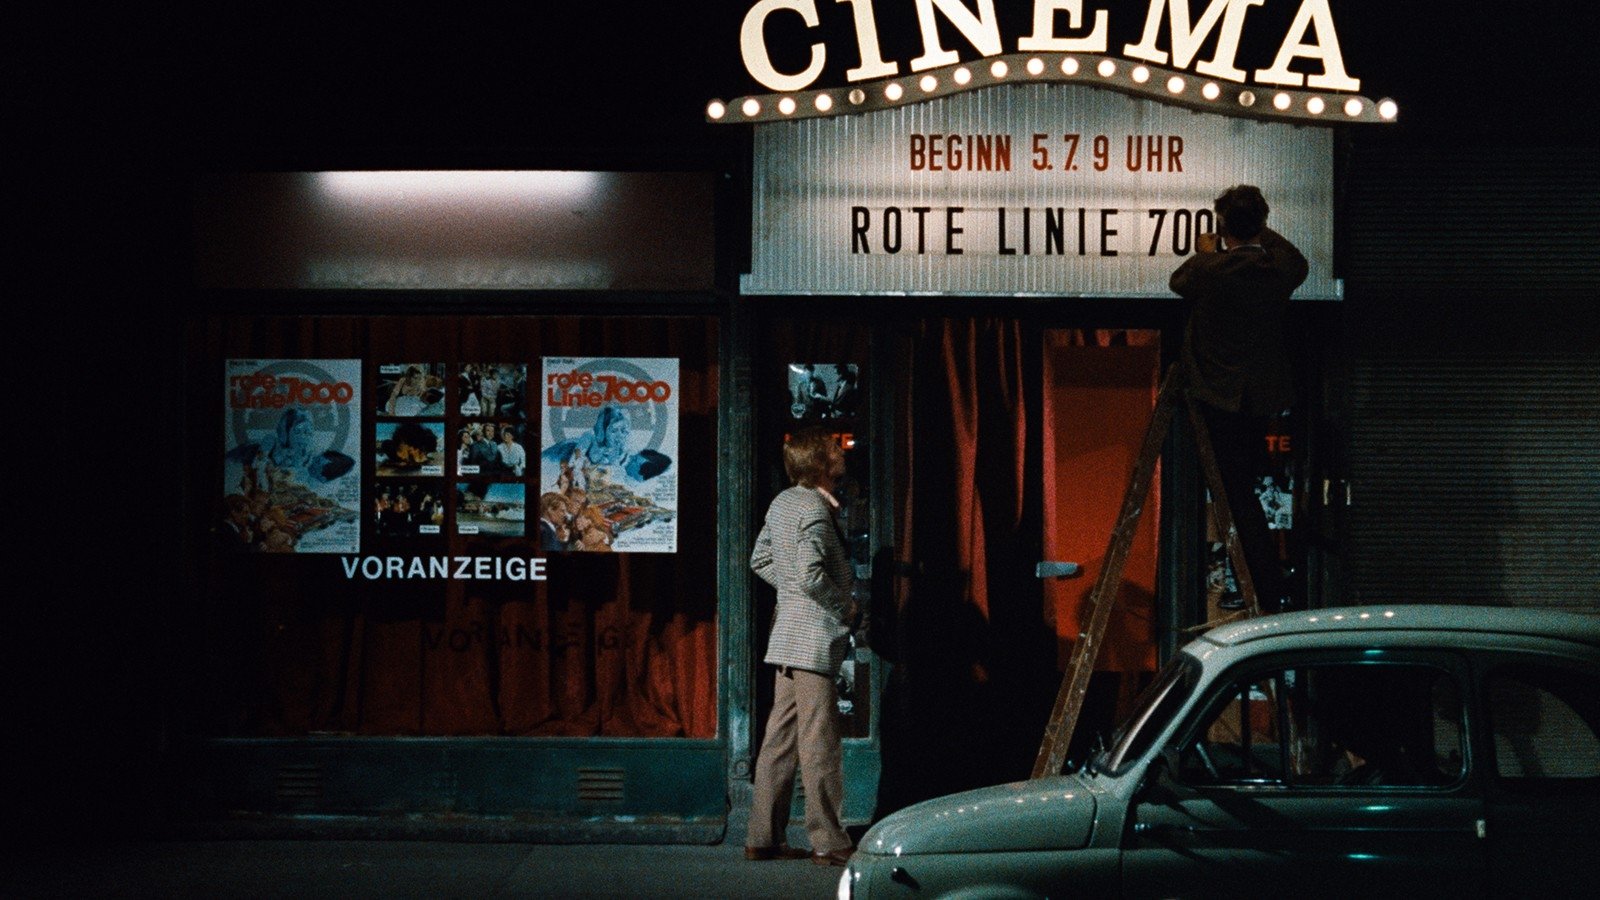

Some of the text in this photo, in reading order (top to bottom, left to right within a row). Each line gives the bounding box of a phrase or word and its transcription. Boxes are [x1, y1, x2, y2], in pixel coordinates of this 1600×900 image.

[740, 0, 1360, 92] CINEMA
[910, 134, 1011, 171] BEGINN
[1093, 135, 1108, 171] 9
[1126, 135, 1183, 172] UHR
[851, 206, 964, 254] ROTE
[998, 206, 1118, 256] LINIE
[279, 377, 354, 405] 7000
[547, 369, 593, 389] rote
[597, 376, 671, 404] 7000
[341, 556, 548, 581] VORANZEIGE
